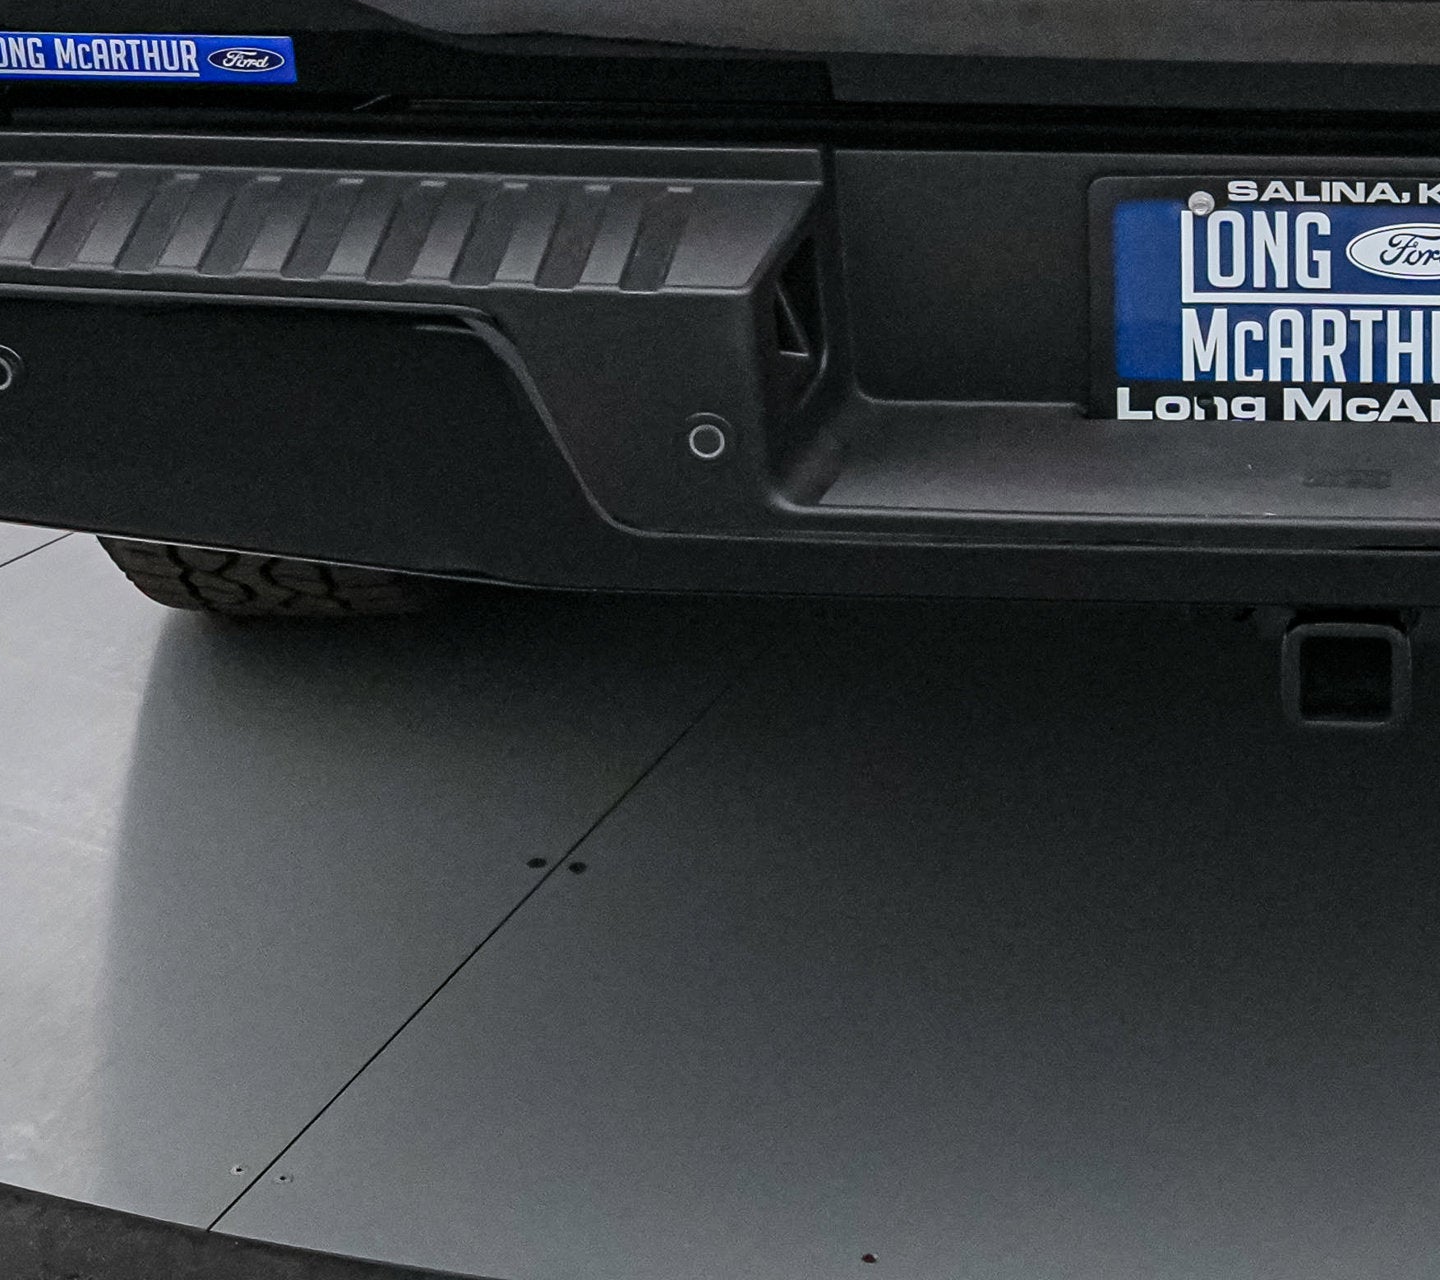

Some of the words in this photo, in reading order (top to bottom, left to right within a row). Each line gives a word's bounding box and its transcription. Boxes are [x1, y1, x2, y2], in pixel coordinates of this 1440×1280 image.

[54, 37, 200, 72] McARTHUR
[221, 50, 270, 69] Ford
[1226, 180, 1412, 204] SALINA,
[1181, 210, 1332, 290] LONG
[1116, 387, 1266, 422] Long
